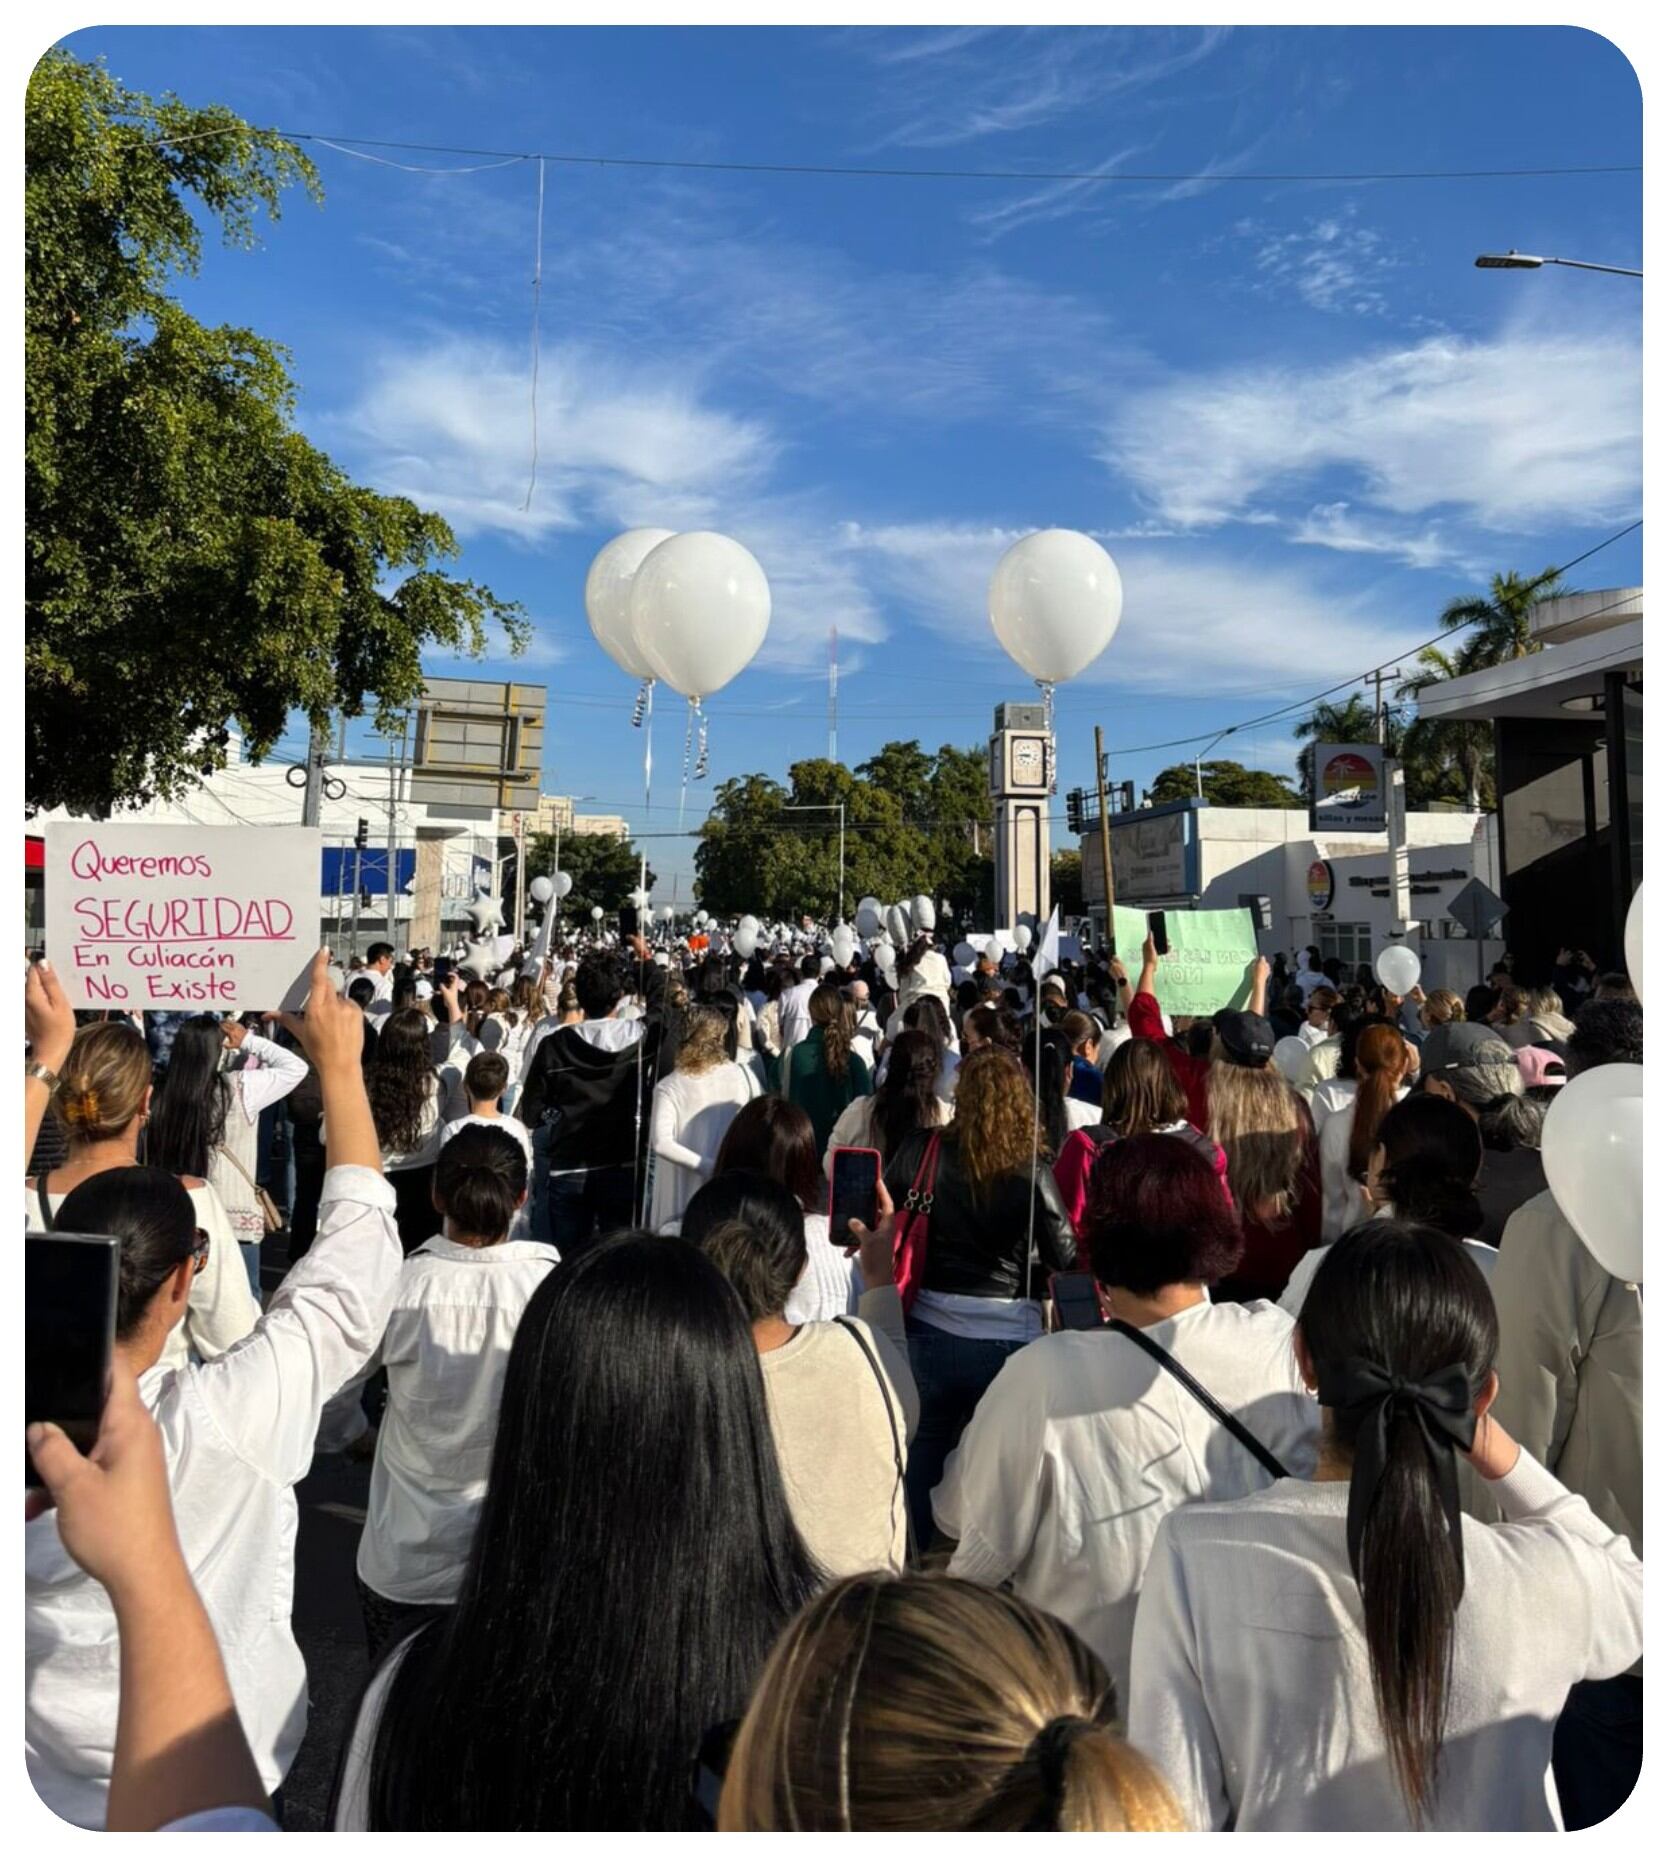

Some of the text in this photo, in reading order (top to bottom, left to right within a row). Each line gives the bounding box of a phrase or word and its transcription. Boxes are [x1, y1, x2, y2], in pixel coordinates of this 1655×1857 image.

[71, 840, 212, 881] Queremos
[74, 896, 293, 939] SEGURIDAD
[73, 943, 235, 969] En Culiacán
[85, 972, 237, 1001] No Existe
